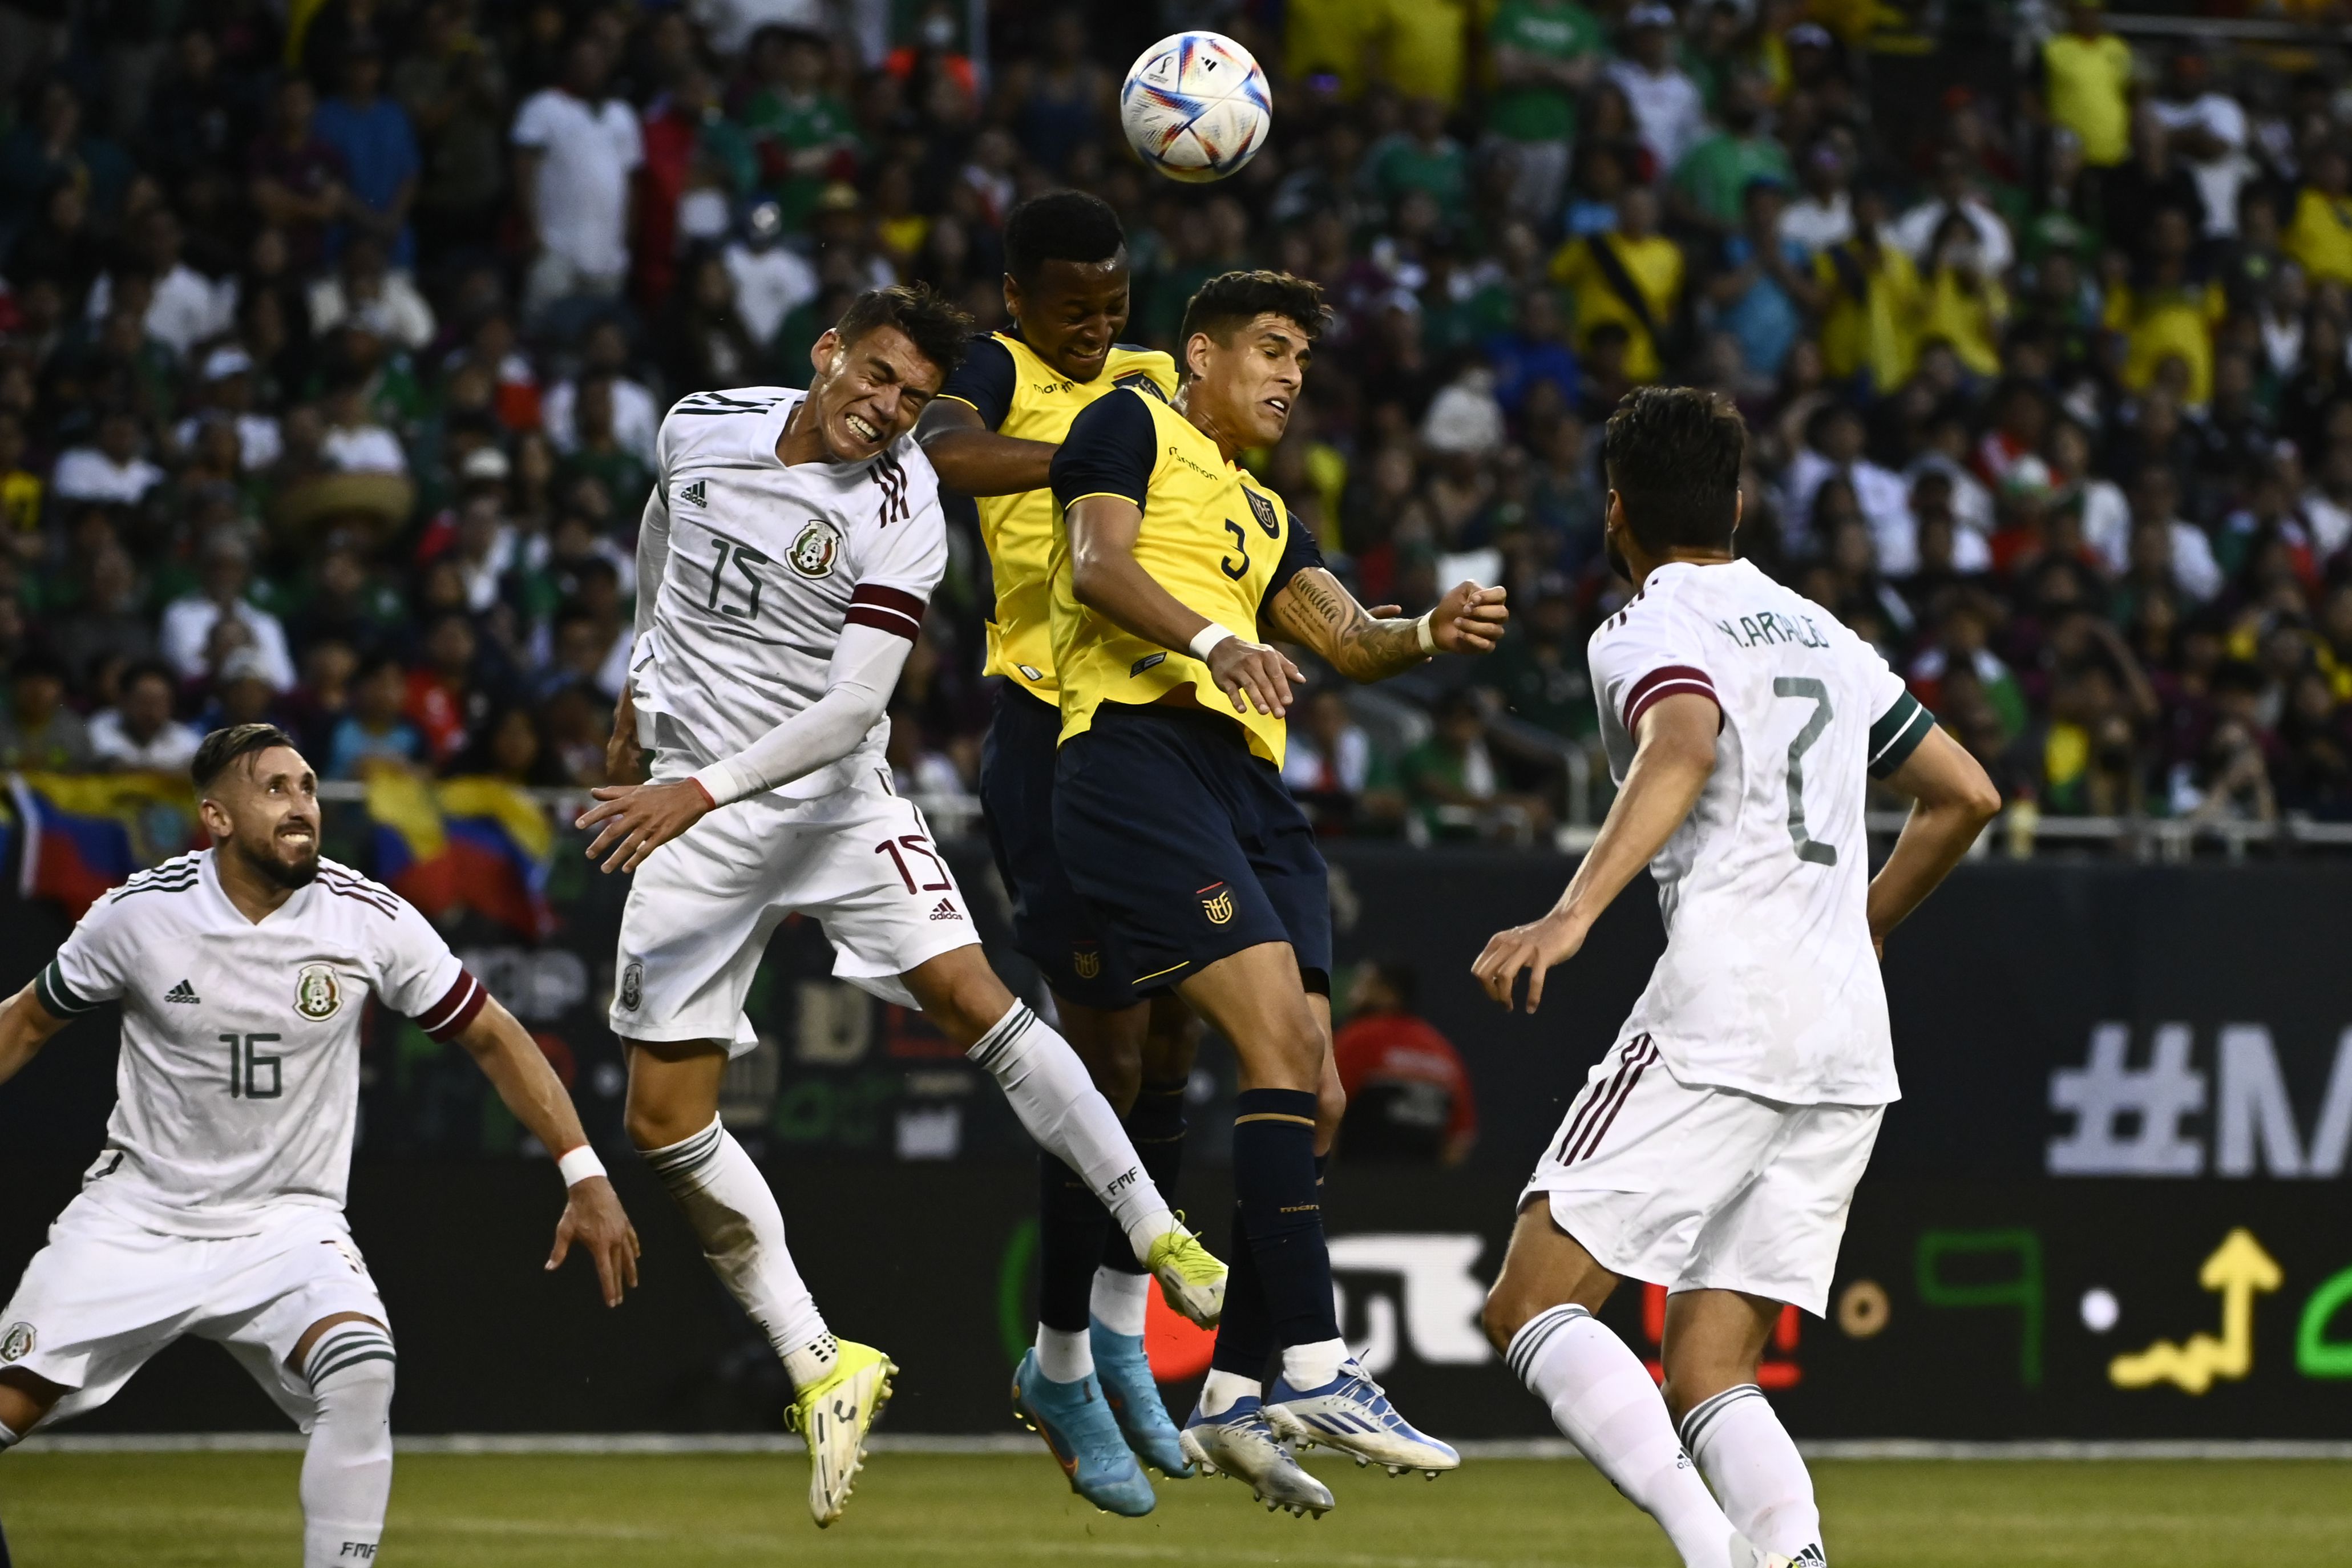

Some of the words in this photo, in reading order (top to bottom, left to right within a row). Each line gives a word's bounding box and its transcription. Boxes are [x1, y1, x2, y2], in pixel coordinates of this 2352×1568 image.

[681, 491, 708, 508] adidas
[1221, 518, 1250, 581] 3
[709, 539, 767, 620] 15
[1773, 677, 1837, 867] 2
[875, 835, 952, 895] 15
[930, 912, 963, 920] adidas
[164, 995, 200, 1004] adidas
[219, 1033, 282, 1099] 16
[1108, 1166, 1137, 1196] FMF
[340, 1542, 378, 1559] FMF
